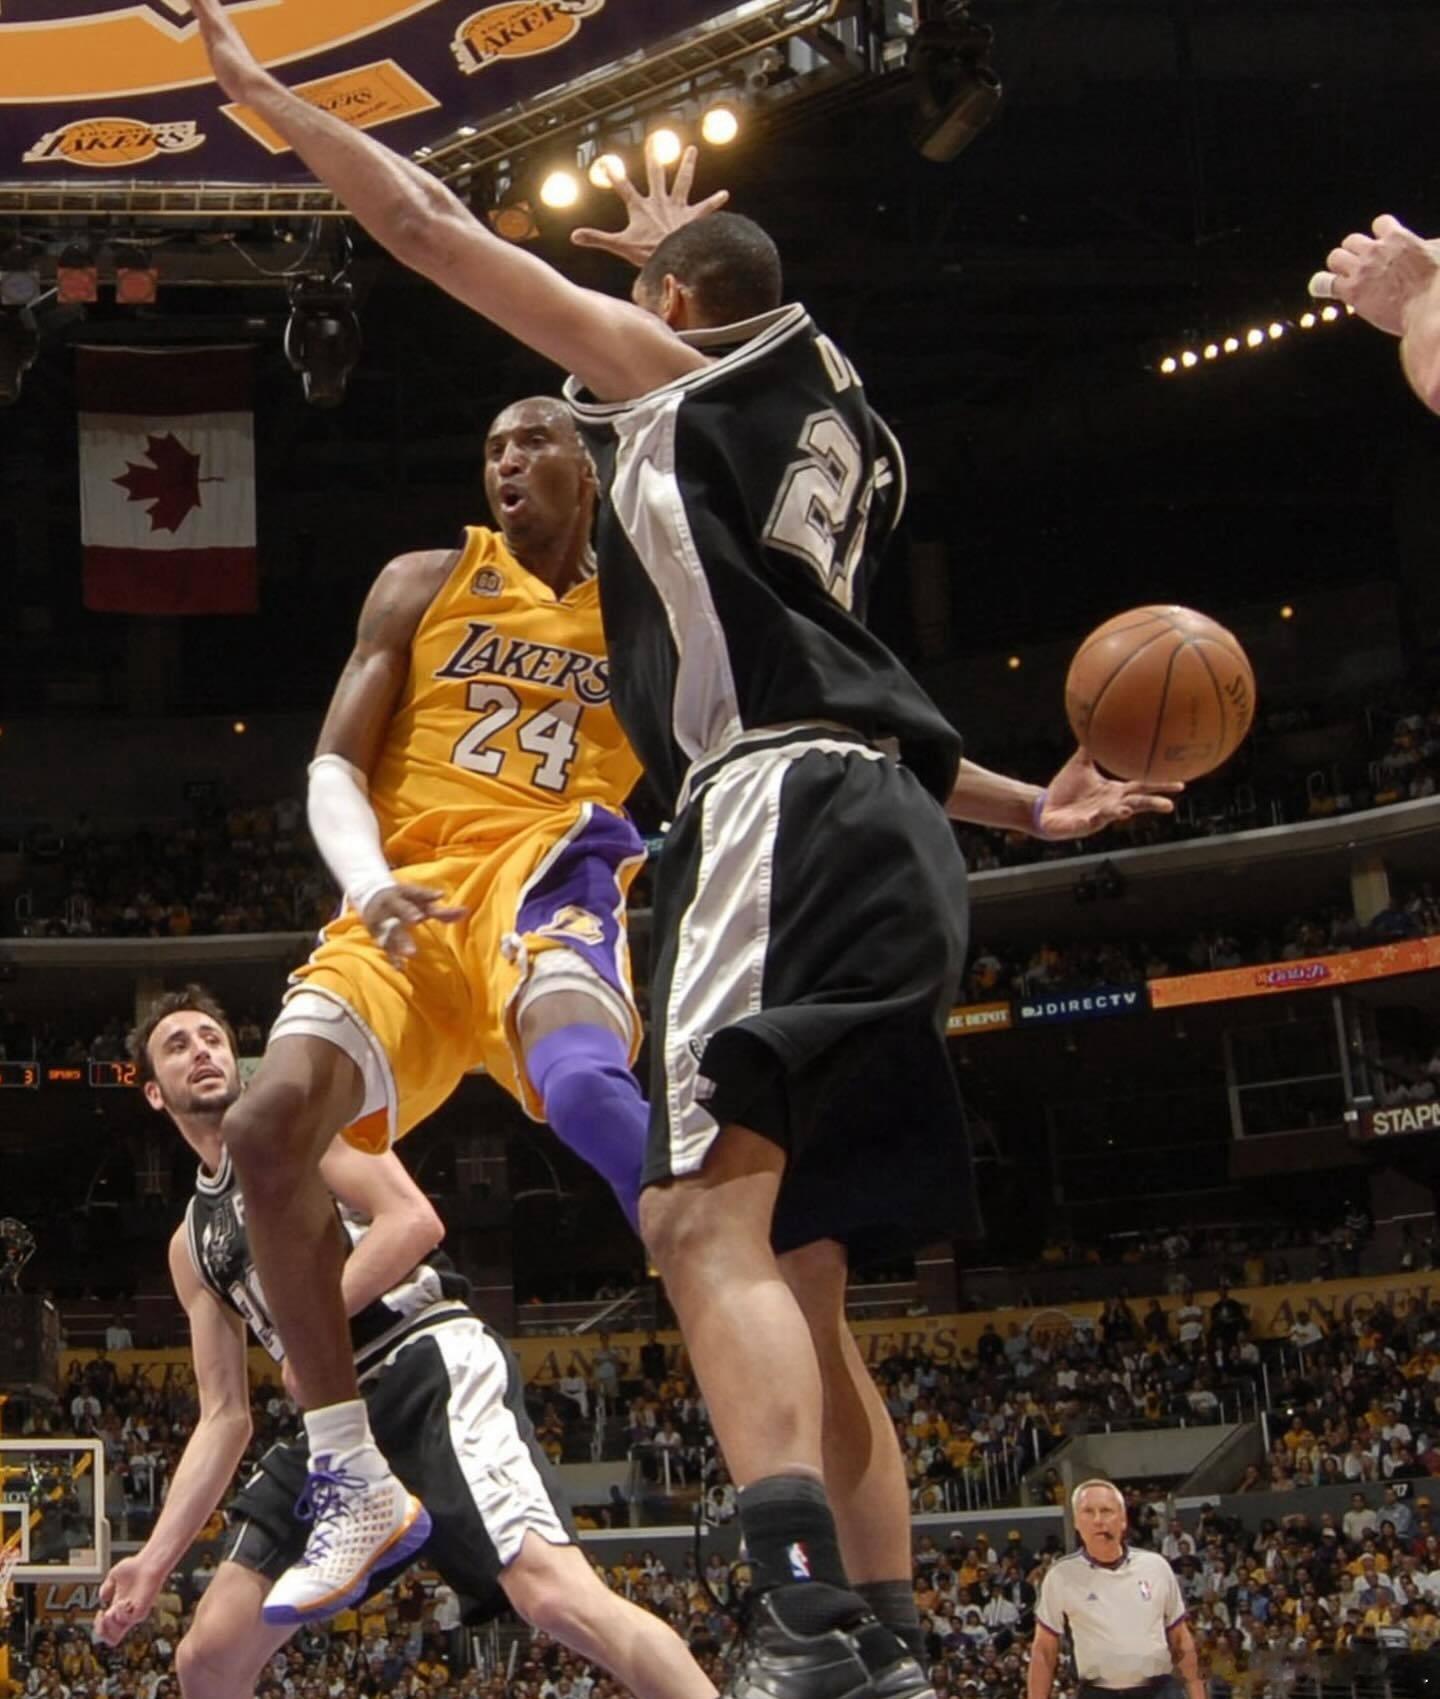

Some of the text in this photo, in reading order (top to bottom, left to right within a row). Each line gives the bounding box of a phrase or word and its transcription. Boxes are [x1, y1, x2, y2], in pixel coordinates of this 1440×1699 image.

[41, 131, 185, 157] LAKERS
[434, 622, 611, 704] LAKERS
[450, 680, 584, 793] 24
[1046, 991, 1137, 1016] DIRECTV
[111, 1063, 137, 1085] 72
